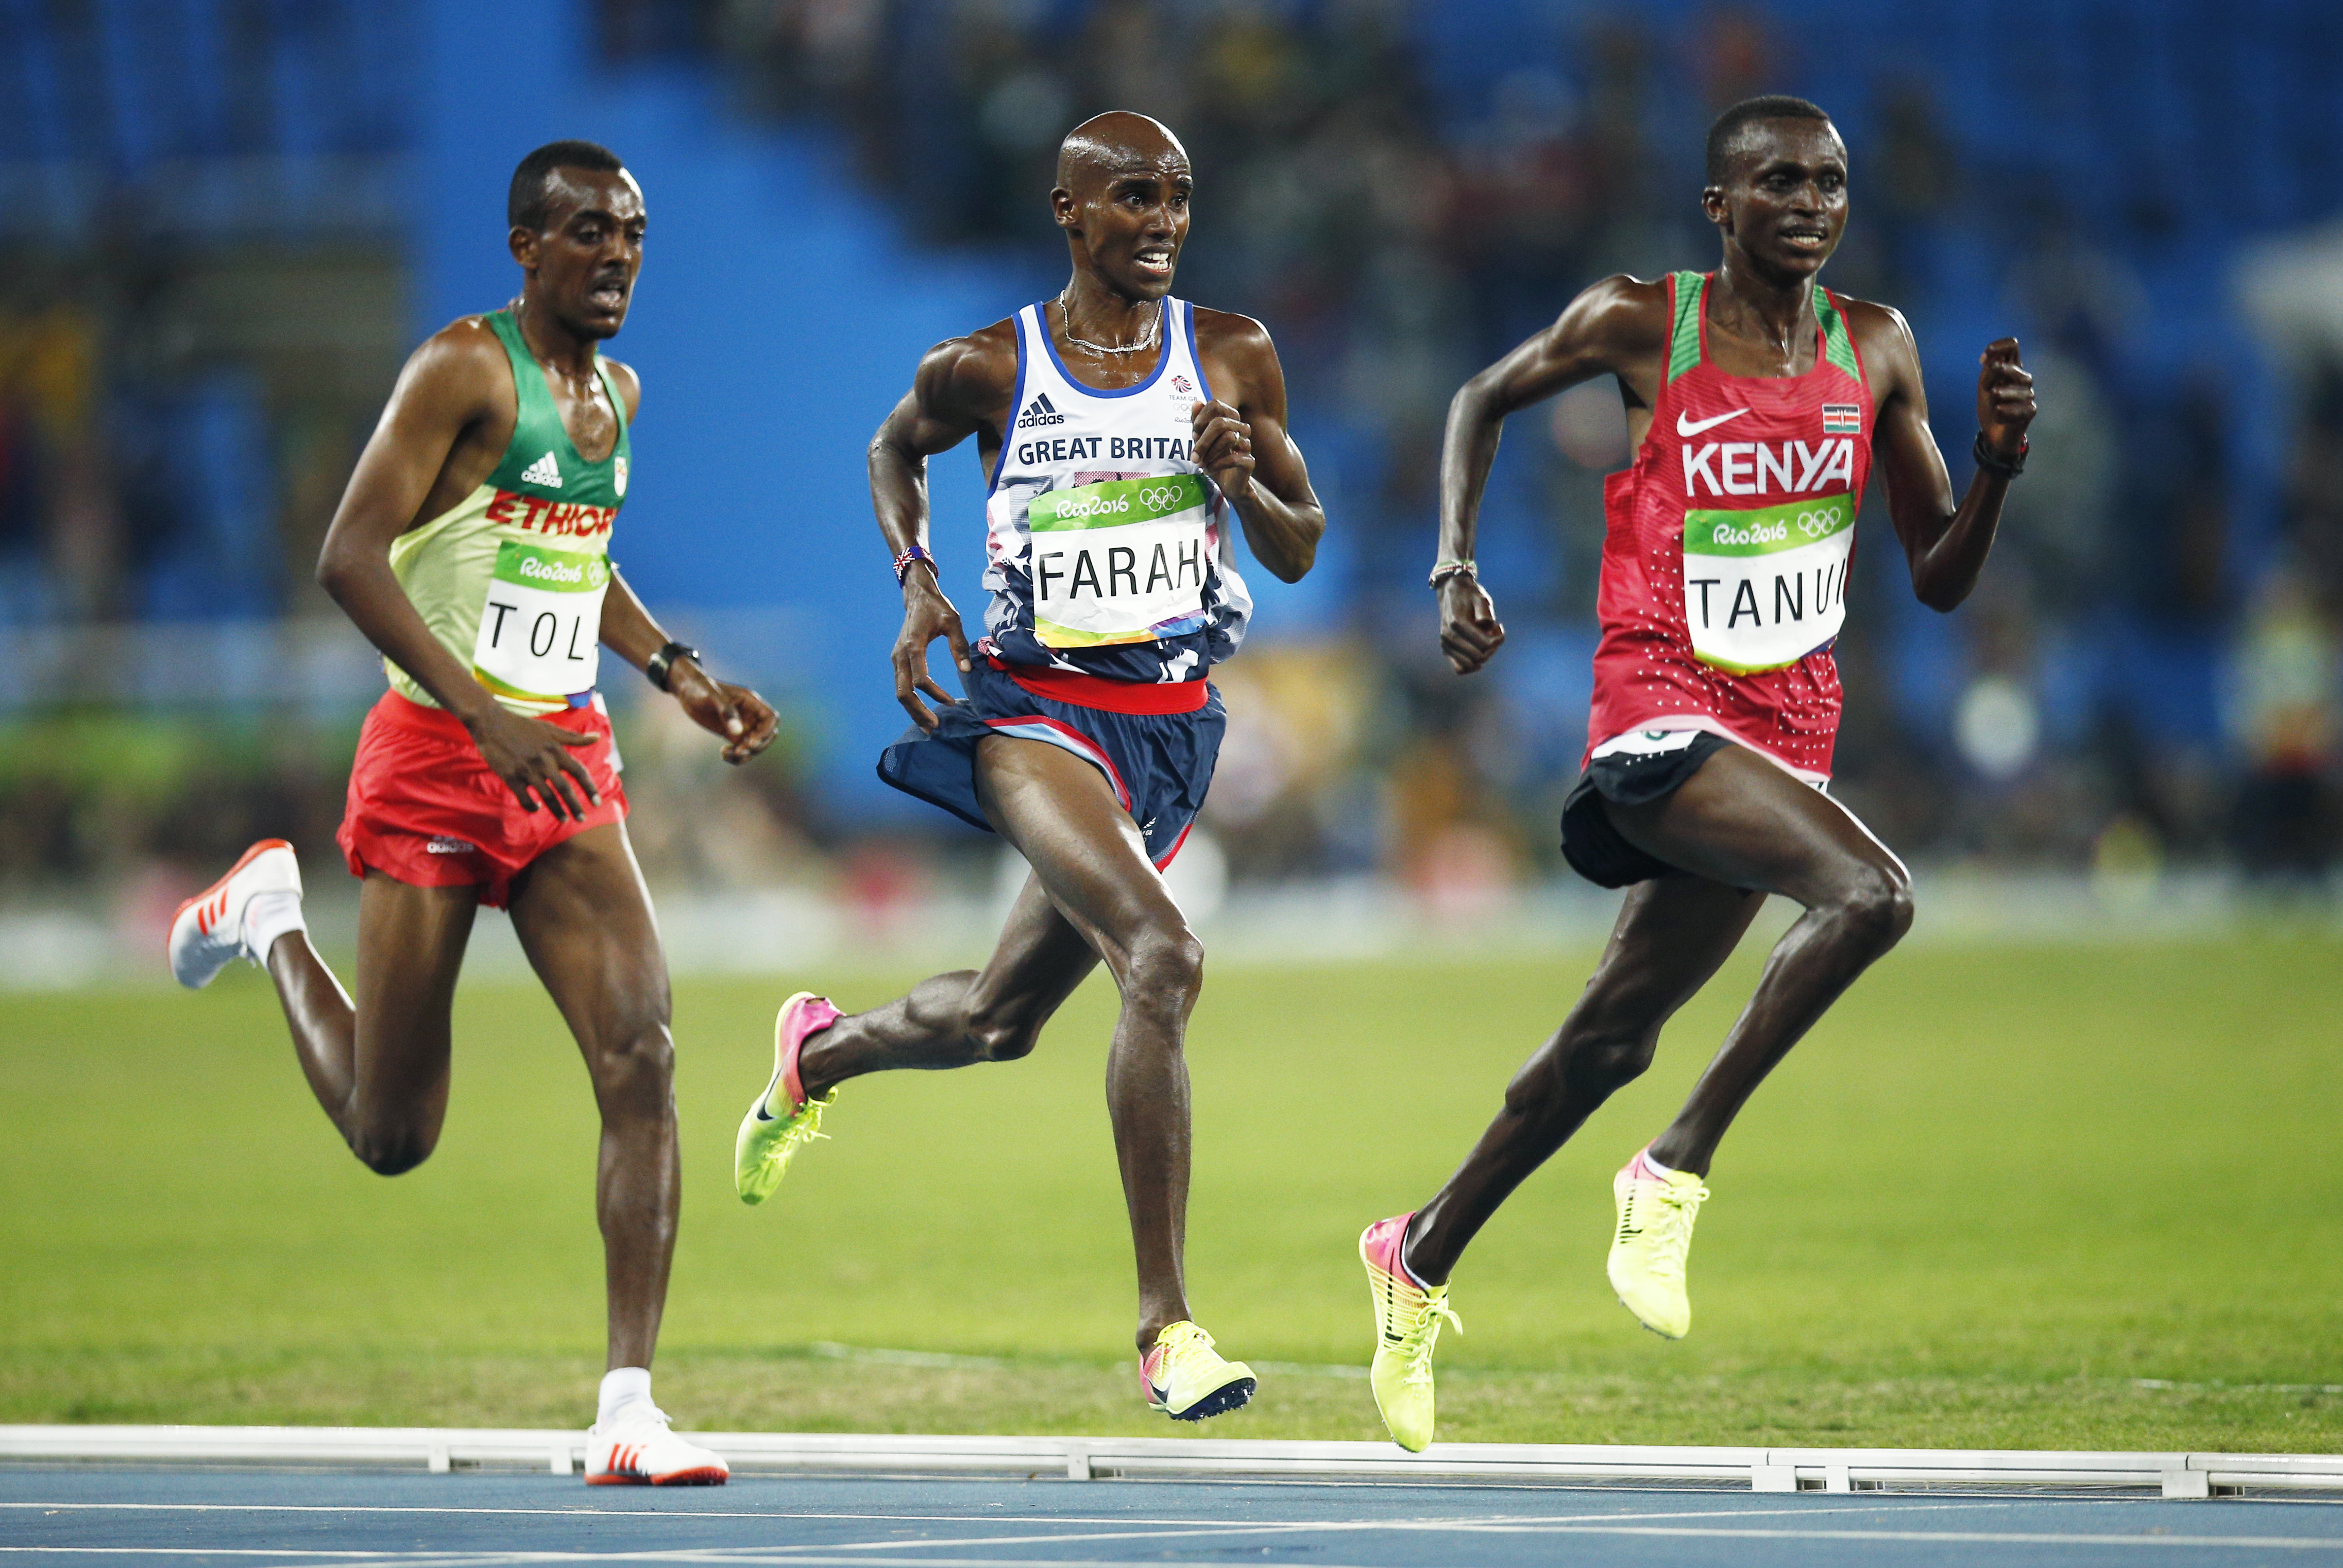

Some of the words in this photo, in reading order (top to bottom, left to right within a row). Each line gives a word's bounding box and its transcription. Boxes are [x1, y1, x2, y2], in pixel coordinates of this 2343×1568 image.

[1018, 413, 1064, 429] adidas
[1018, 437, 1102, 465] GREAT
[1111, 437, 1193, 462] BRITAI
[520, 469, 563, 489] adidas
[1682, 438, 1853, 497] KENYA
[485, 488, 618, 537] ETHIOP
[1056, 493, 1129, 519] Rio2016
[1712, 519, 1788, 546] Rio2016
[519, 556, 583, 584] Rio2016
[1039, 538, 1201, 601] FARAH
[1689, 557, 1846, 629] TANUI
[489, 602, 599, 661] TOL
